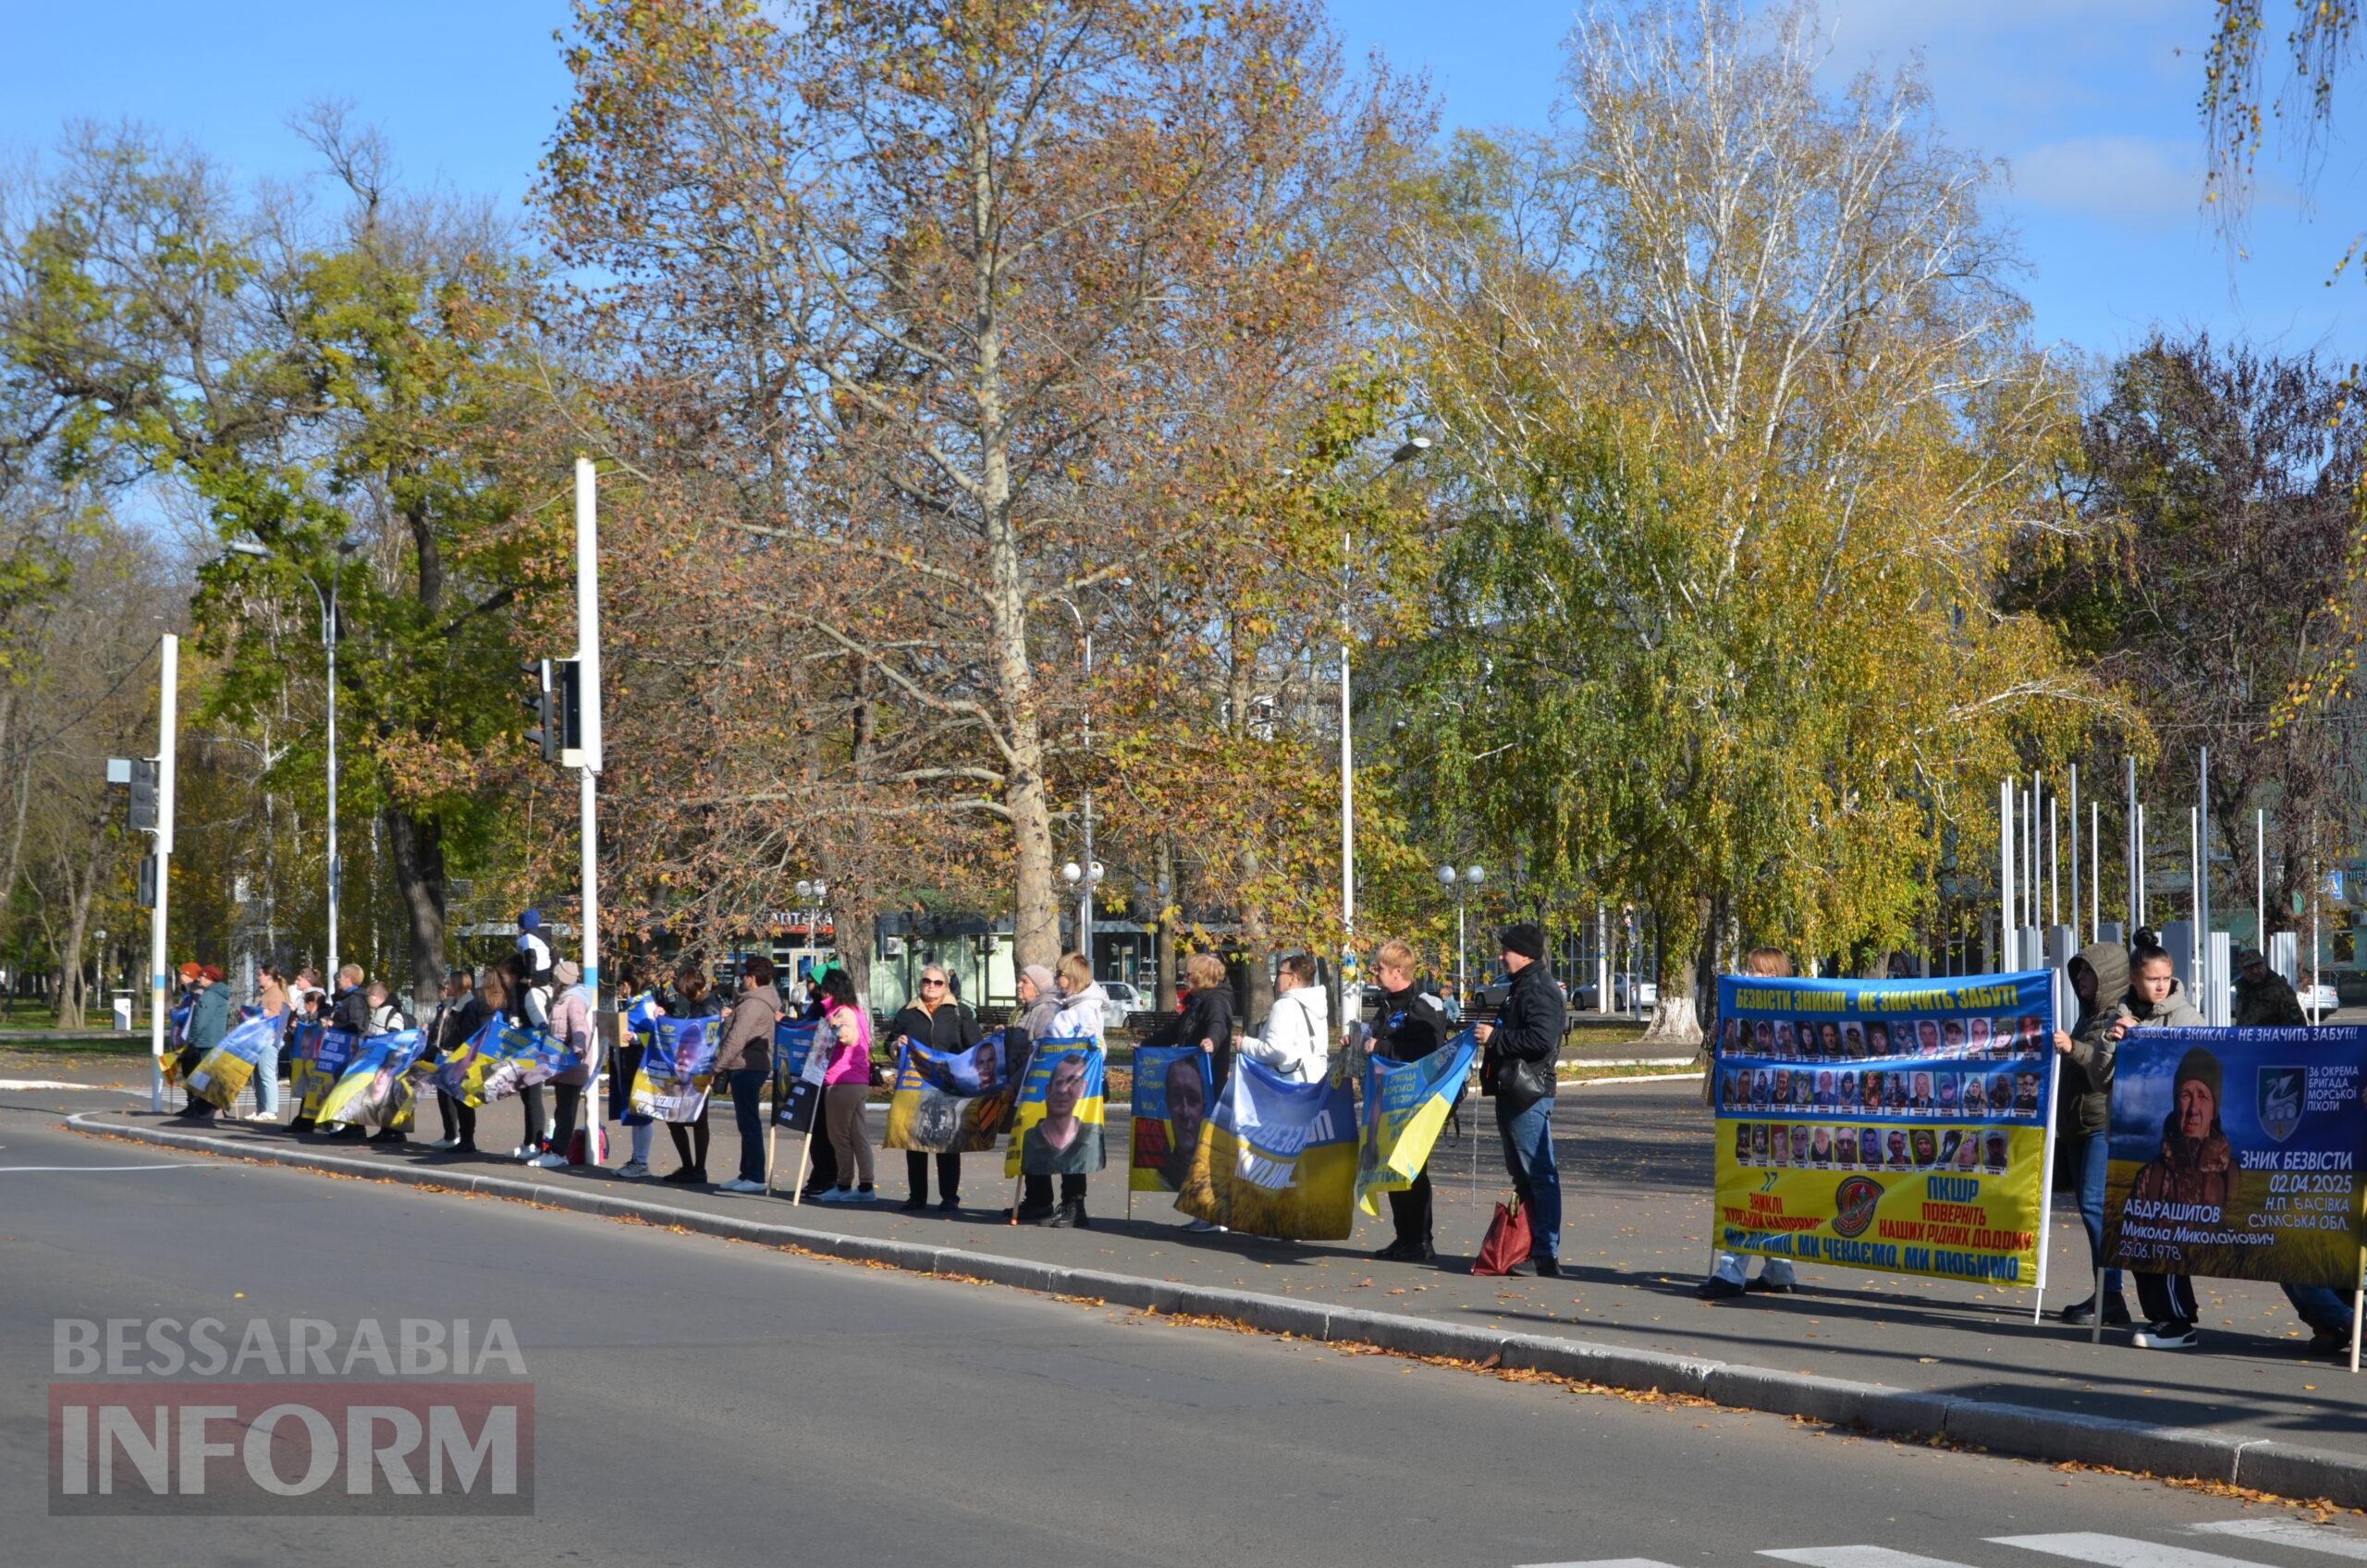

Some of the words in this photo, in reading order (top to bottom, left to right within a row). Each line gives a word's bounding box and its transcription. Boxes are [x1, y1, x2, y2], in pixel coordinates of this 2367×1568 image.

[1735, 988, 1791, 1011] БЕЗВІСТИ
[1794, 990, 1846, 1011] ЗНИКЛІ
[1858, 991, 1877, 1012] НЕ
[1879, 989, 1955, 1012] ЗНАЧИТЬ
[1956, 985, 2018, 1010] ЗАБУТІ
[2185, 1027, 2227, 1041] ЗНИКЛІ
[2238, 1028, 2254, 1042] НЕ
[2256, 1028, 2309, 1042] ЗНАЧИТЬ
[2309, 1066, 2319, 1077] 36
[2321, 1066, 2359, 1077] ОКРЕМА
[2307, 1086, 2357, 1100] МОРСЬКОЇ
[2308, 1078, 2349, 1089] БРИГАДА
[2307, 1101, 2339, 1111] ПІХОТИ
[2239, 1150, 2281, 1170] ЗНИК
[2283, 1151, 2352, 1170] БЕЗВІСТИ
[1927, 1175, 1980, 1203] ПКШР
[2269, 1174, 2353, 1194] 02.04.2025
[2123, 1198, 2221, 1224] АБДРАШИТОВ
[2264, 1196, 2290, 1211] Н.П.
[2293, 1196, 2349, 1212] БАСІВКА
[1921, 1202, 1987, 1227] ПОВЕРНІТЬ
[2248, 1213, 2316, 1229] СУМСЬКА
[2319, 1215, 2349, 1231] ОБЛ.
[1879, 1219, 1924, 1242] НАШИХ
[1926, 1224, 1970, 1246] РІДНИХ
[1970, 1228, 2032, 1252] ДОДОМУ
[2121, 1219, 2171, 1241] Микола
[2173, 1226, 2275, 1245] Миколайович
[1797, 1234, 1821, 1258] МИ
[1904, 1246, 1931, 1271] МИ
[1934, 1249, 2018, 1281] ЛЮБИМО
[2118, 1241, 2182, 1261] 25.06.1978
